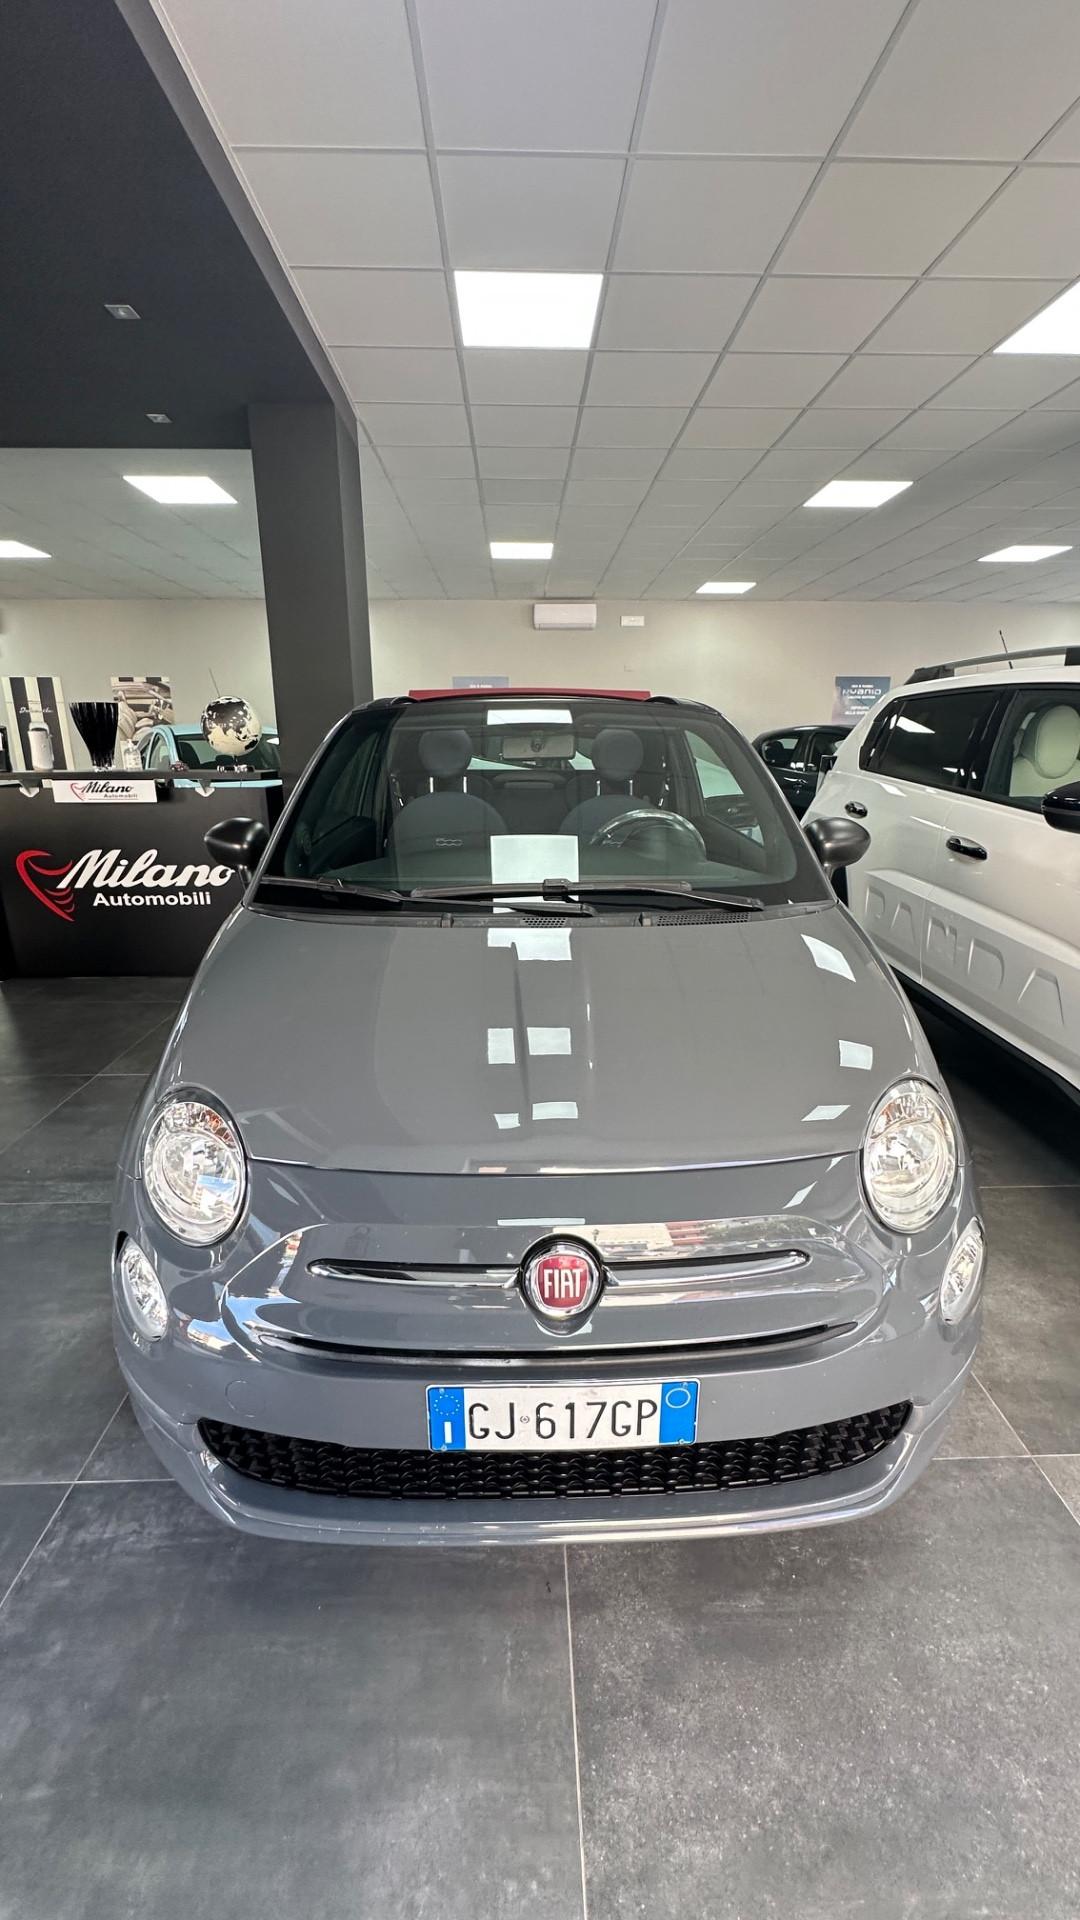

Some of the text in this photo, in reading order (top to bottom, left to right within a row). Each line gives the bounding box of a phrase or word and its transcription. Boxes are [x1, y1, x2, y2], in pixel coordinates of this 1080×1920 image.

[81, 781, 134, 793] Milano
[56, 849, 235, 889] Milano
[93, 892, 211, 907] Automobili
[543, 1268, 583, 1299] FIAT
